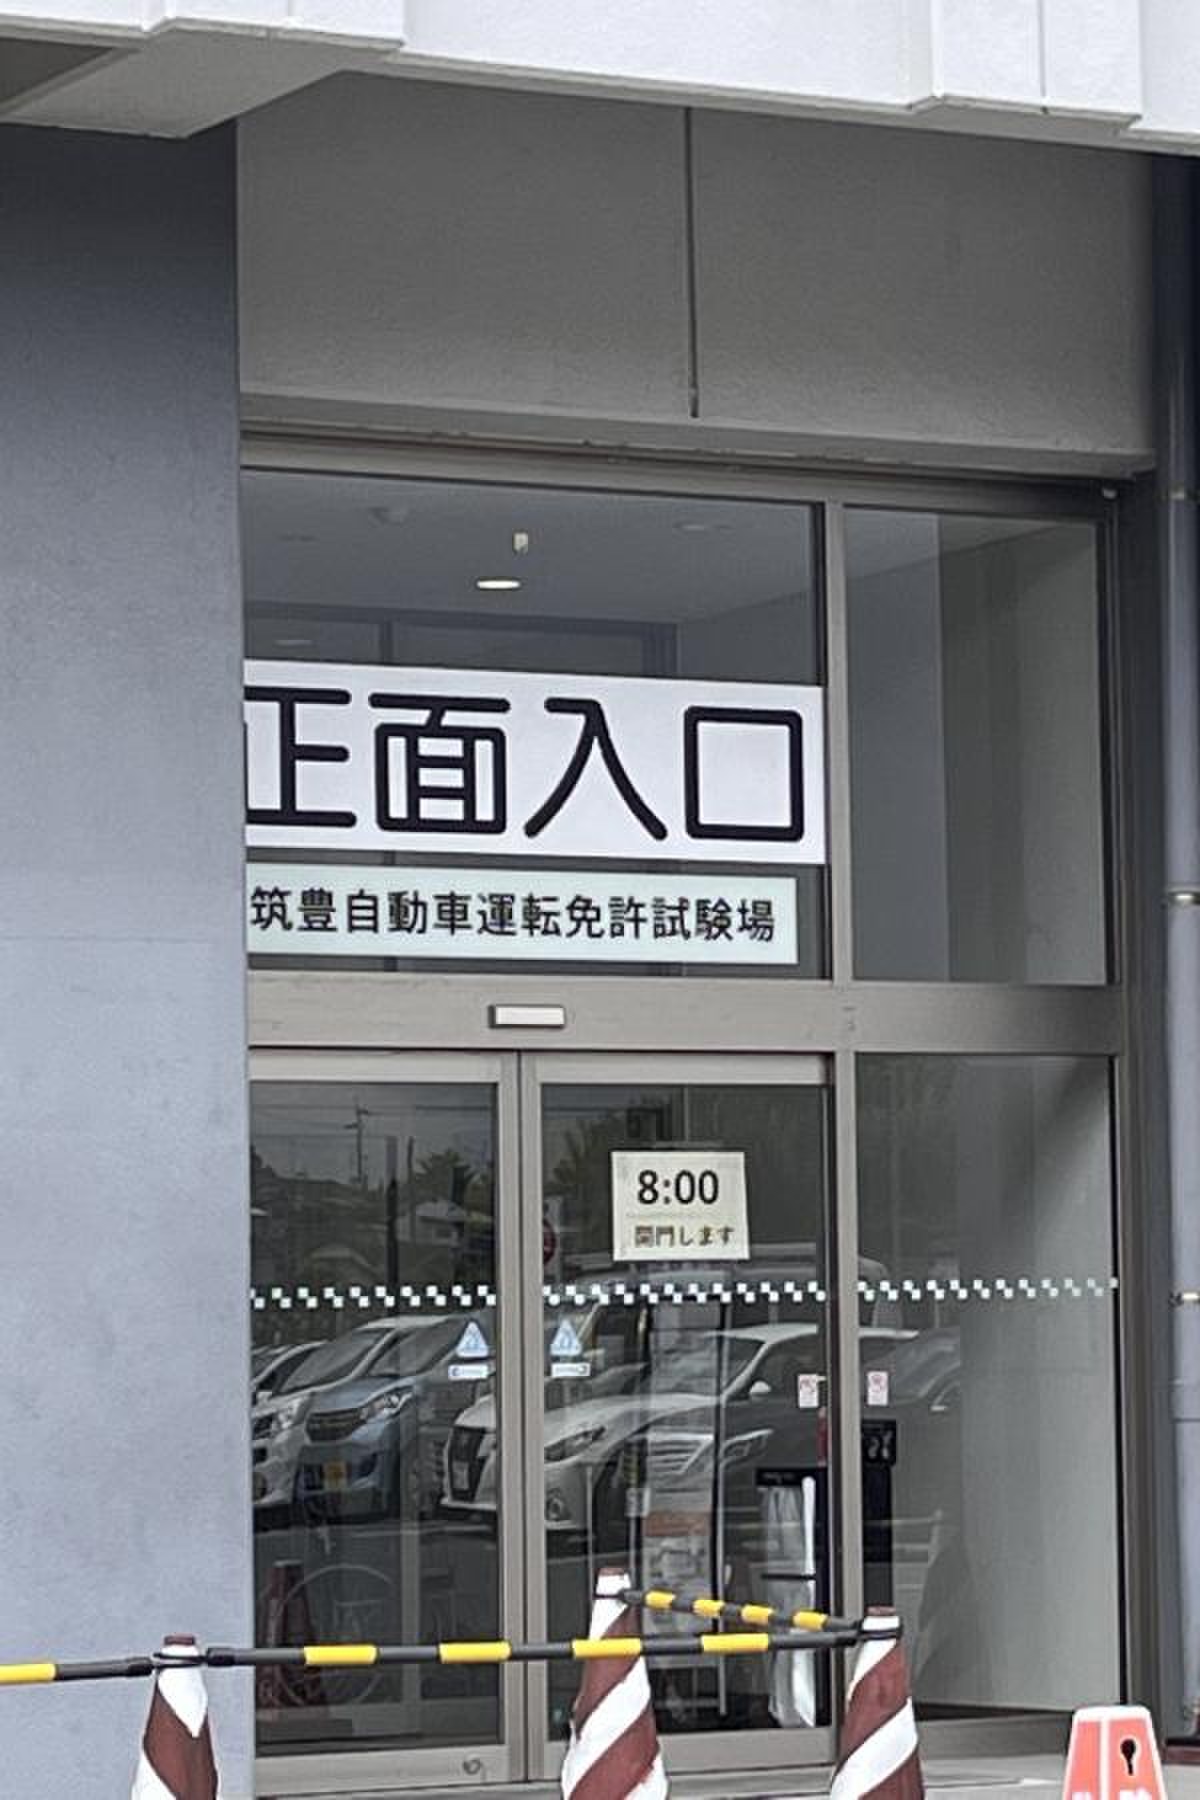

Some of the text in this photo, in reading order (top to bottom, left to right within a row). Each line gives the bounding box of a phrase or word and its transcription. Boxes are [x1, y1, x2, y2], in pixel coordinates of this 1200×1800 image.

[245, 686, 804, 842] 正面入口
[250, 886, 775, 942] 筑豊自動車運転免許試験場
[638, 1170, 719, 1205] 8:00
